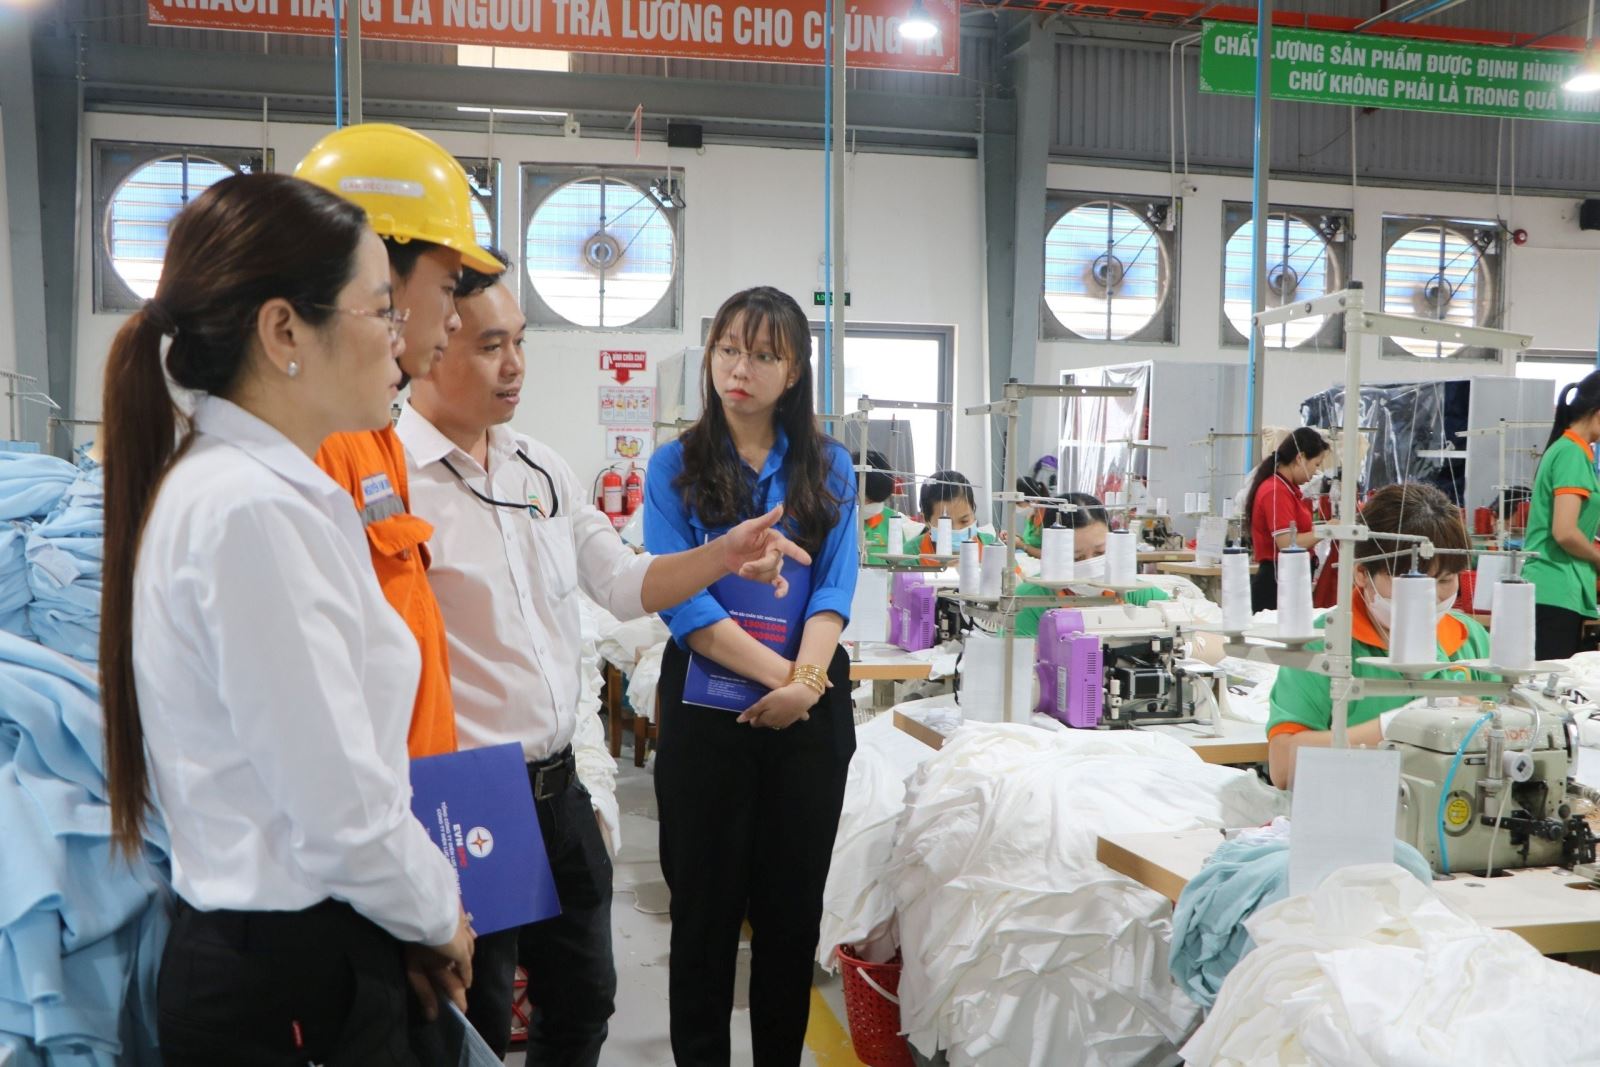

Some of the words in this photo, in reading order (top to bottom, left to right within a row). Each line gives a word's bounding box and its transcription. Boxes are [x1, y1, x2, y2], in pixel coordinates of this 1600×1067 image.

[733, 5, 793, 48] CHO
[803, 6, 902, 55] CÚNG
[1270, 40, 1324, 64] ƯỢNG
[1330, 41, 1366, 67] SẢN
[1371, 45, 1422, 72] PHẨM
[1427, 54, 1472, 79] ĐƯỢC
[1476, 58, 1518, 82] ĐỊNH
[1522, 59, 1564, 83] HÌNH
[1288, 69, 1326, 91] CHỨ
[1330, 73, 1389, 97] KHÔNG
[1394, 76, 1434, 101] PHẢI
[1439, 81, 1459, 103] LÀ
[1464, 85, 1520, 108] TRONG
